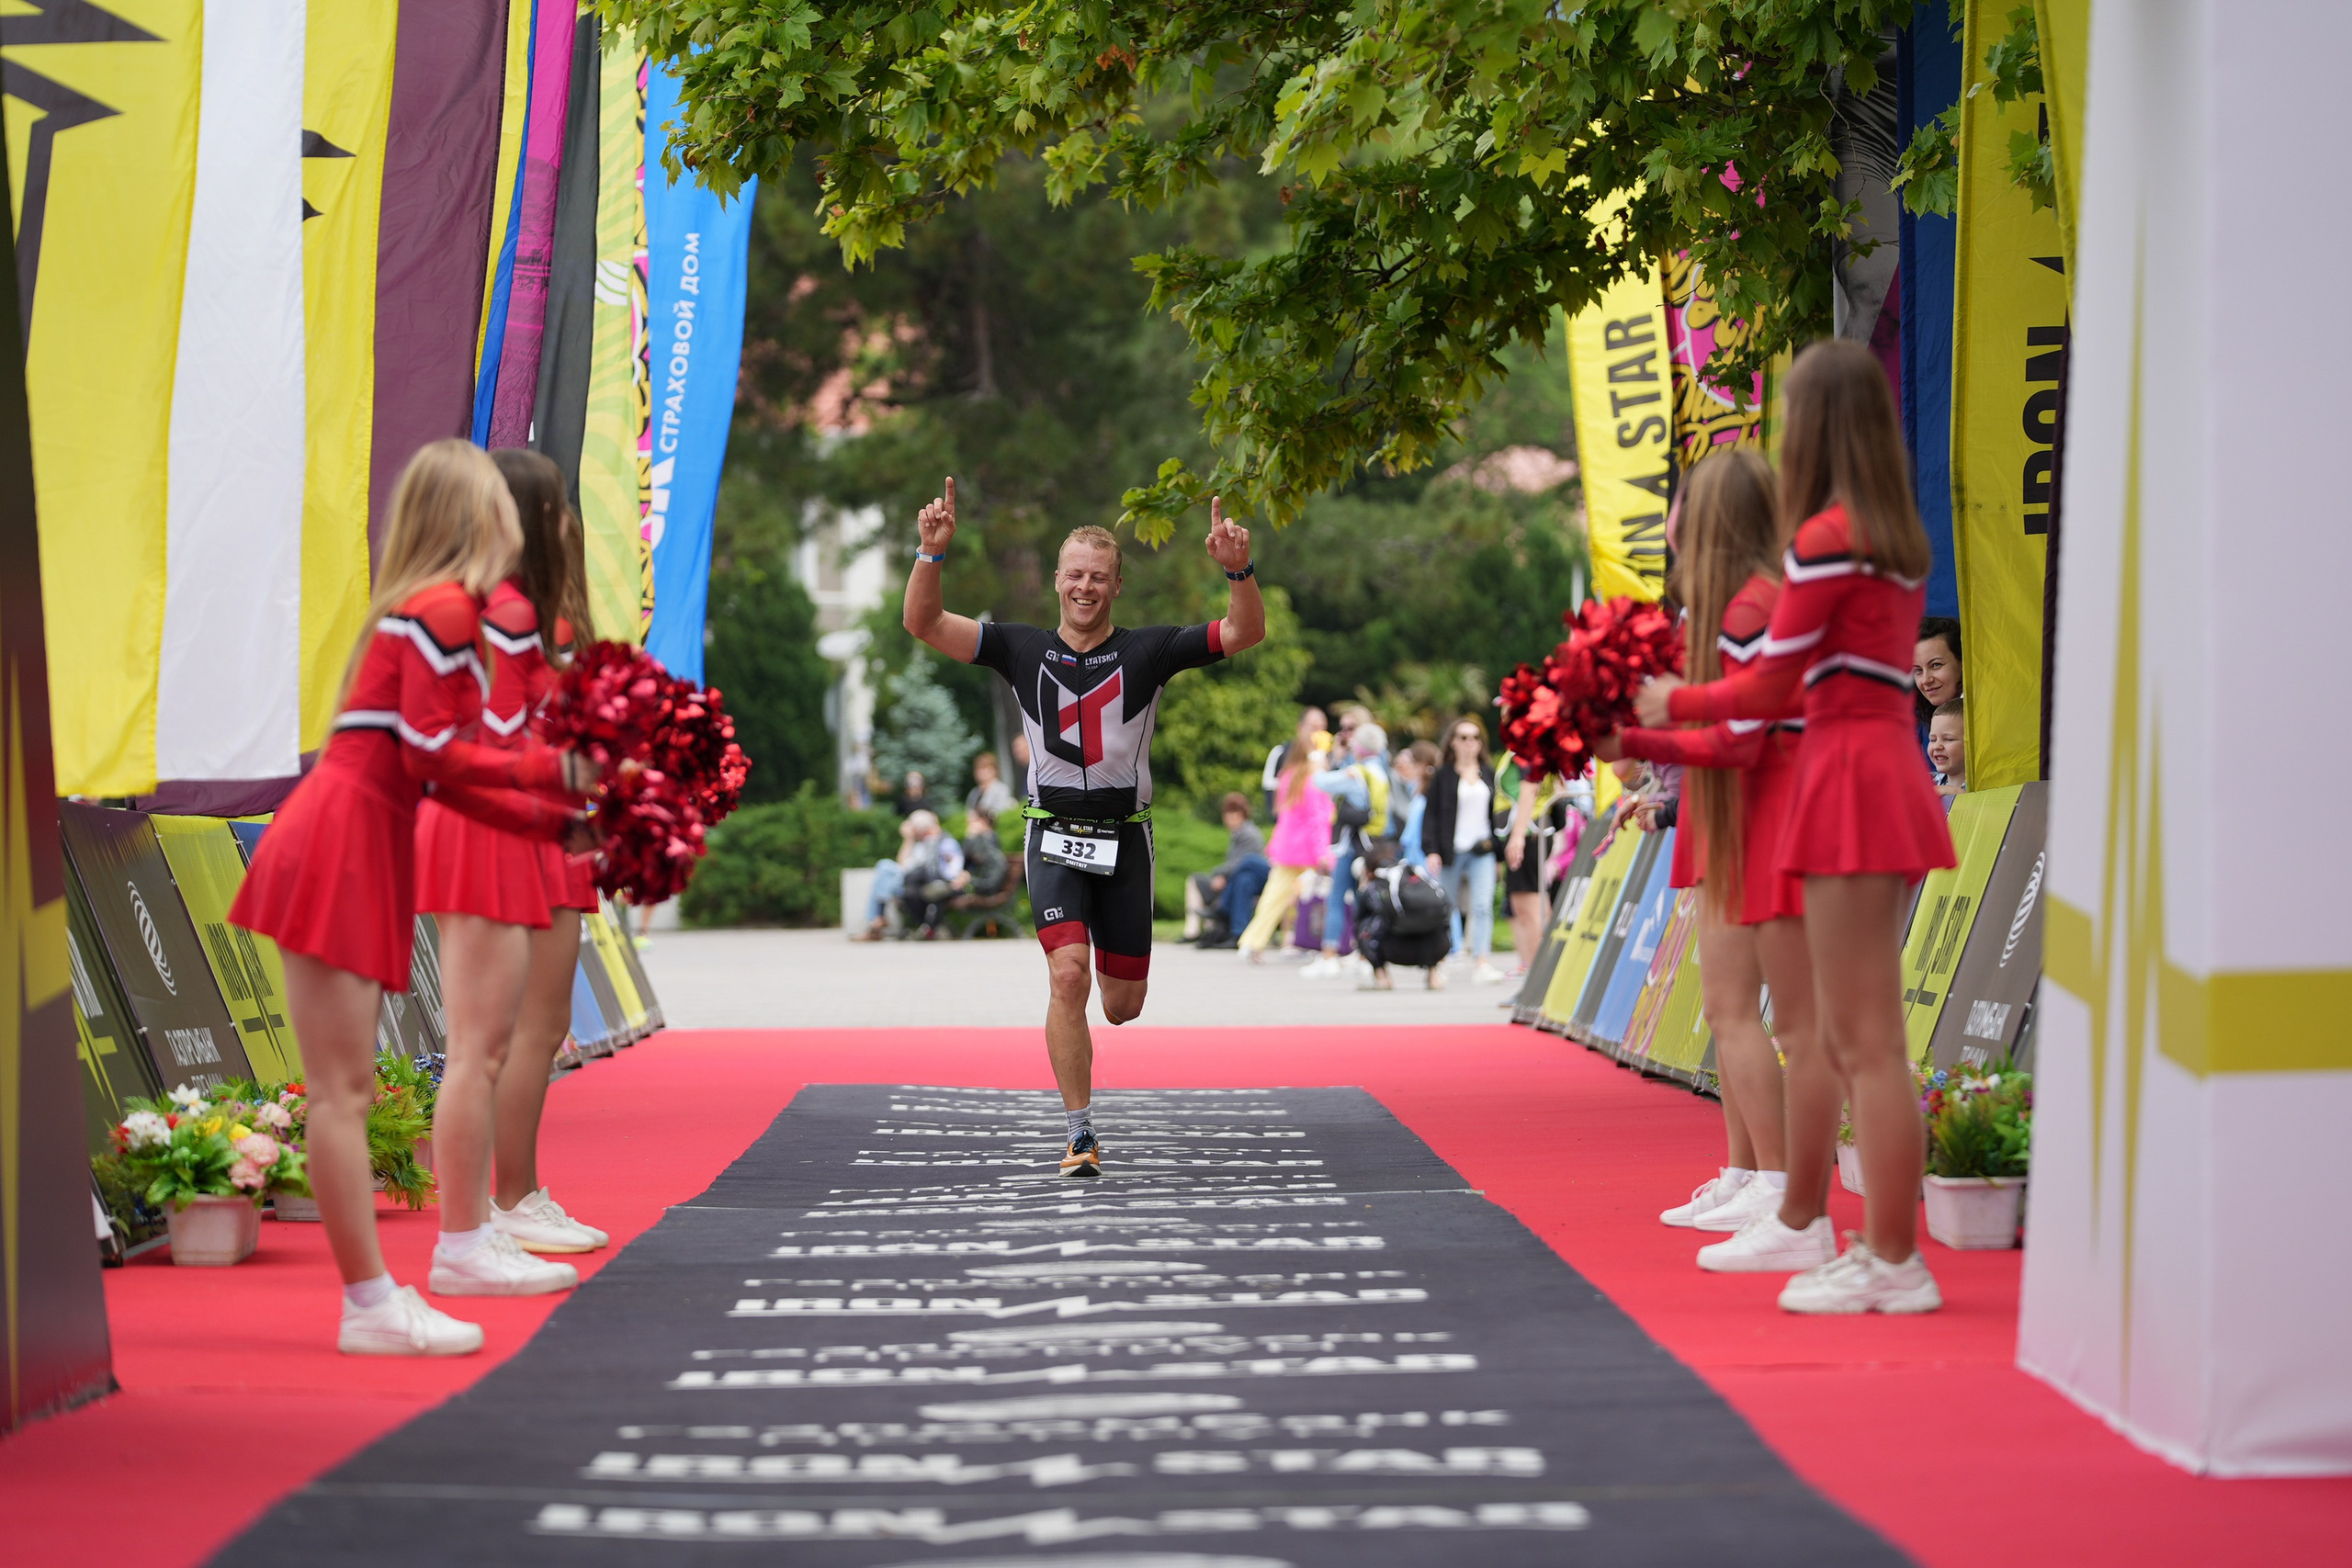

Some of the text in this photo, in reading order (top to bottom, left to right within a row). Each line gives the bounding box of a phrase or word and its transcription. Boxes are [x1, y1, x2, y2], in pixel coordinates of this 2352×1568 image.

[660, 299, 695, 454] СТРАХОВОЙ
[680, 232, 700, 295] ДОМ
[1604, 313, 1667, 448] STAR
[1061, 840, 1096, 860] 332
[1066, 859, 1088, 869] DMITRIY
